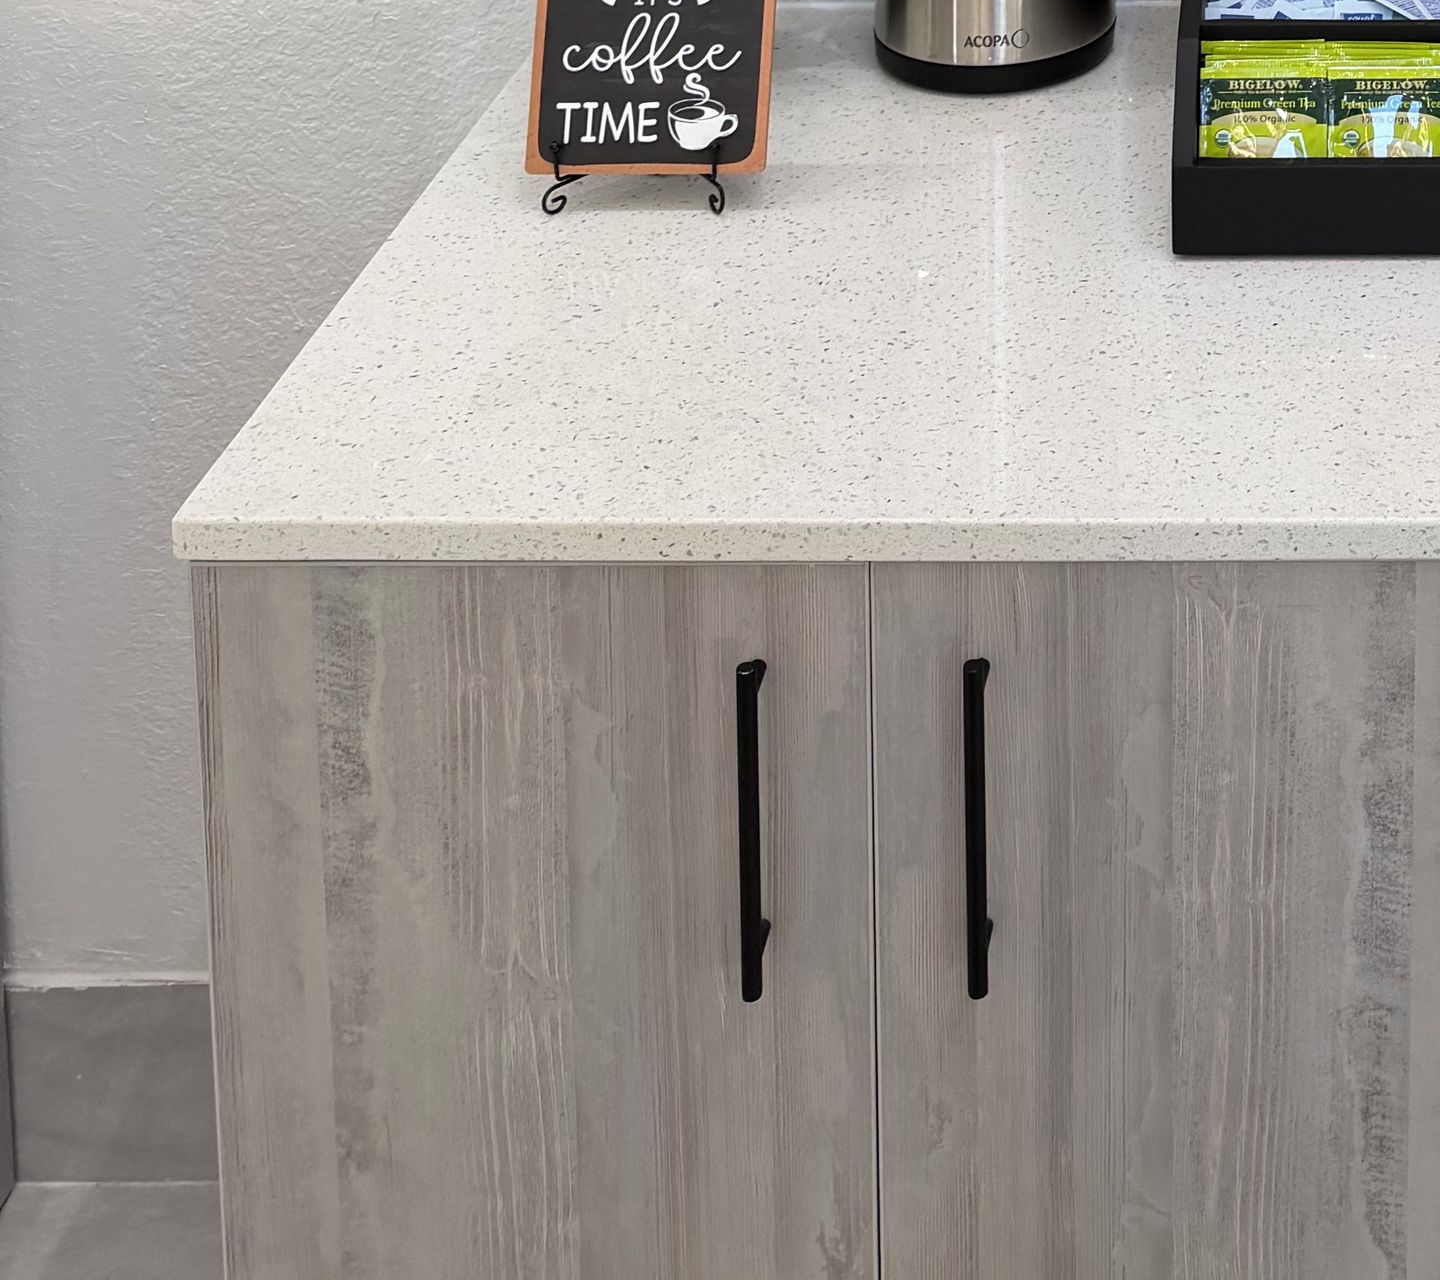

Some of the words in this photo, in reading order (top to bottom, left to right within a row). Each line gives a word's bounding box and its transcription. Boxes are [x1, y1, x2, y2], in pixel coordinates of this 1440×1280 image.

[562, 12, 742, 84] coffee
[964, 35, 1010, 49] ACOPA
[1228, 79, 1301, 90] BIGELOW
[1355, 80, 1427, 91] BIGELOW
[1212, 98, 1260, 110] Premium
[1262, 97, 1296, 109] Green
[1298, 97, 1316, 109] Tea
[1341, 99, 1385, 110] Premium
[556, 102, 660, 144] TIME
[1234, 115, 1257, 124] 100%
